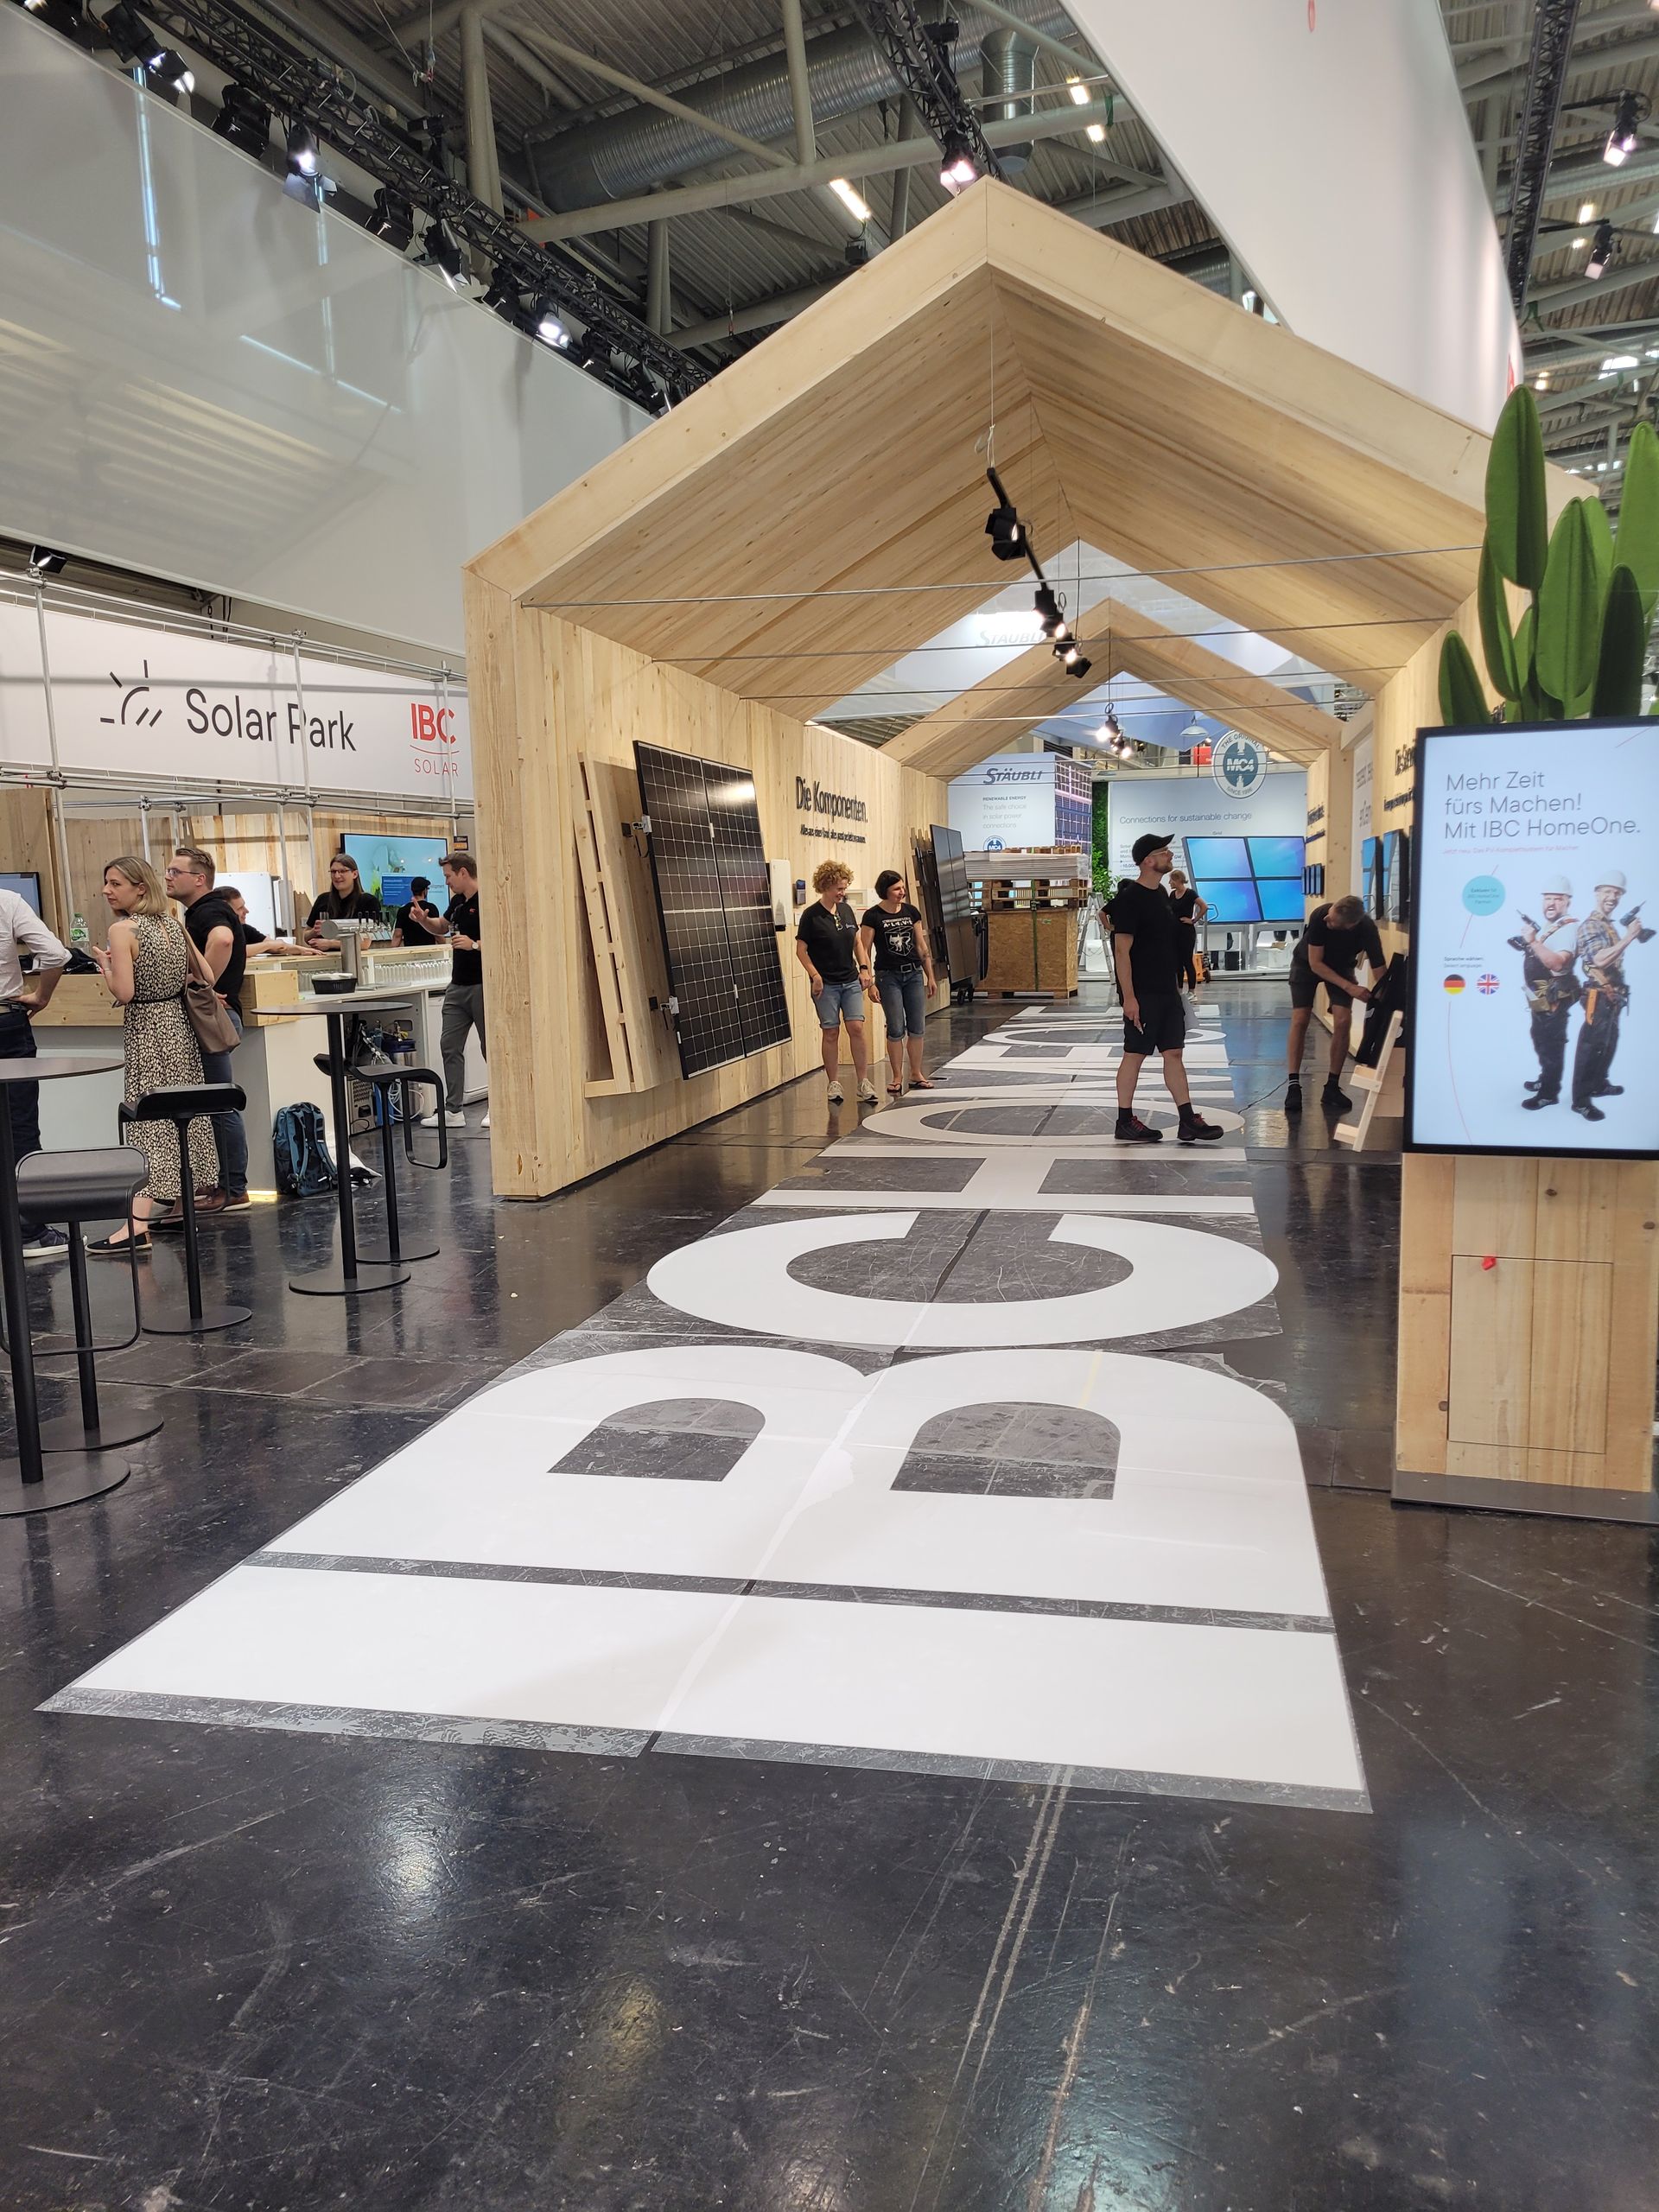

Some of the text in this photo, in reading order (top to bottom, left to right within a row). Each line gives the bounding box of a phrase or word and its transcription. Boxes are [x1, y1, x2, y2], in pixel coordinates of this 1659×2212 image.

[186, 688, 357, 752] Solar Park
[410, 702, 457, 745] IBC
[1221, 736, 1233, 748] THE
[414, 758, 459, 777] SOLAR
[1226, 758, 1255, 772] MC4
[982, 767, 1043, 785] STÄUBLI
[1446, 771, 1545, 791] Mehr Zeit
[796, 776, 868, 823] Die Komponenten.
[1445, 792, 1581, 815] fürs Machen!
[1120, 816, 1166, 824] Connections
[1179, 813, 1221, 822] sustainable
[1224, 812, 1252, 821] change
[1445, 817, 1641, 839] Mit IBC HomeOne.
